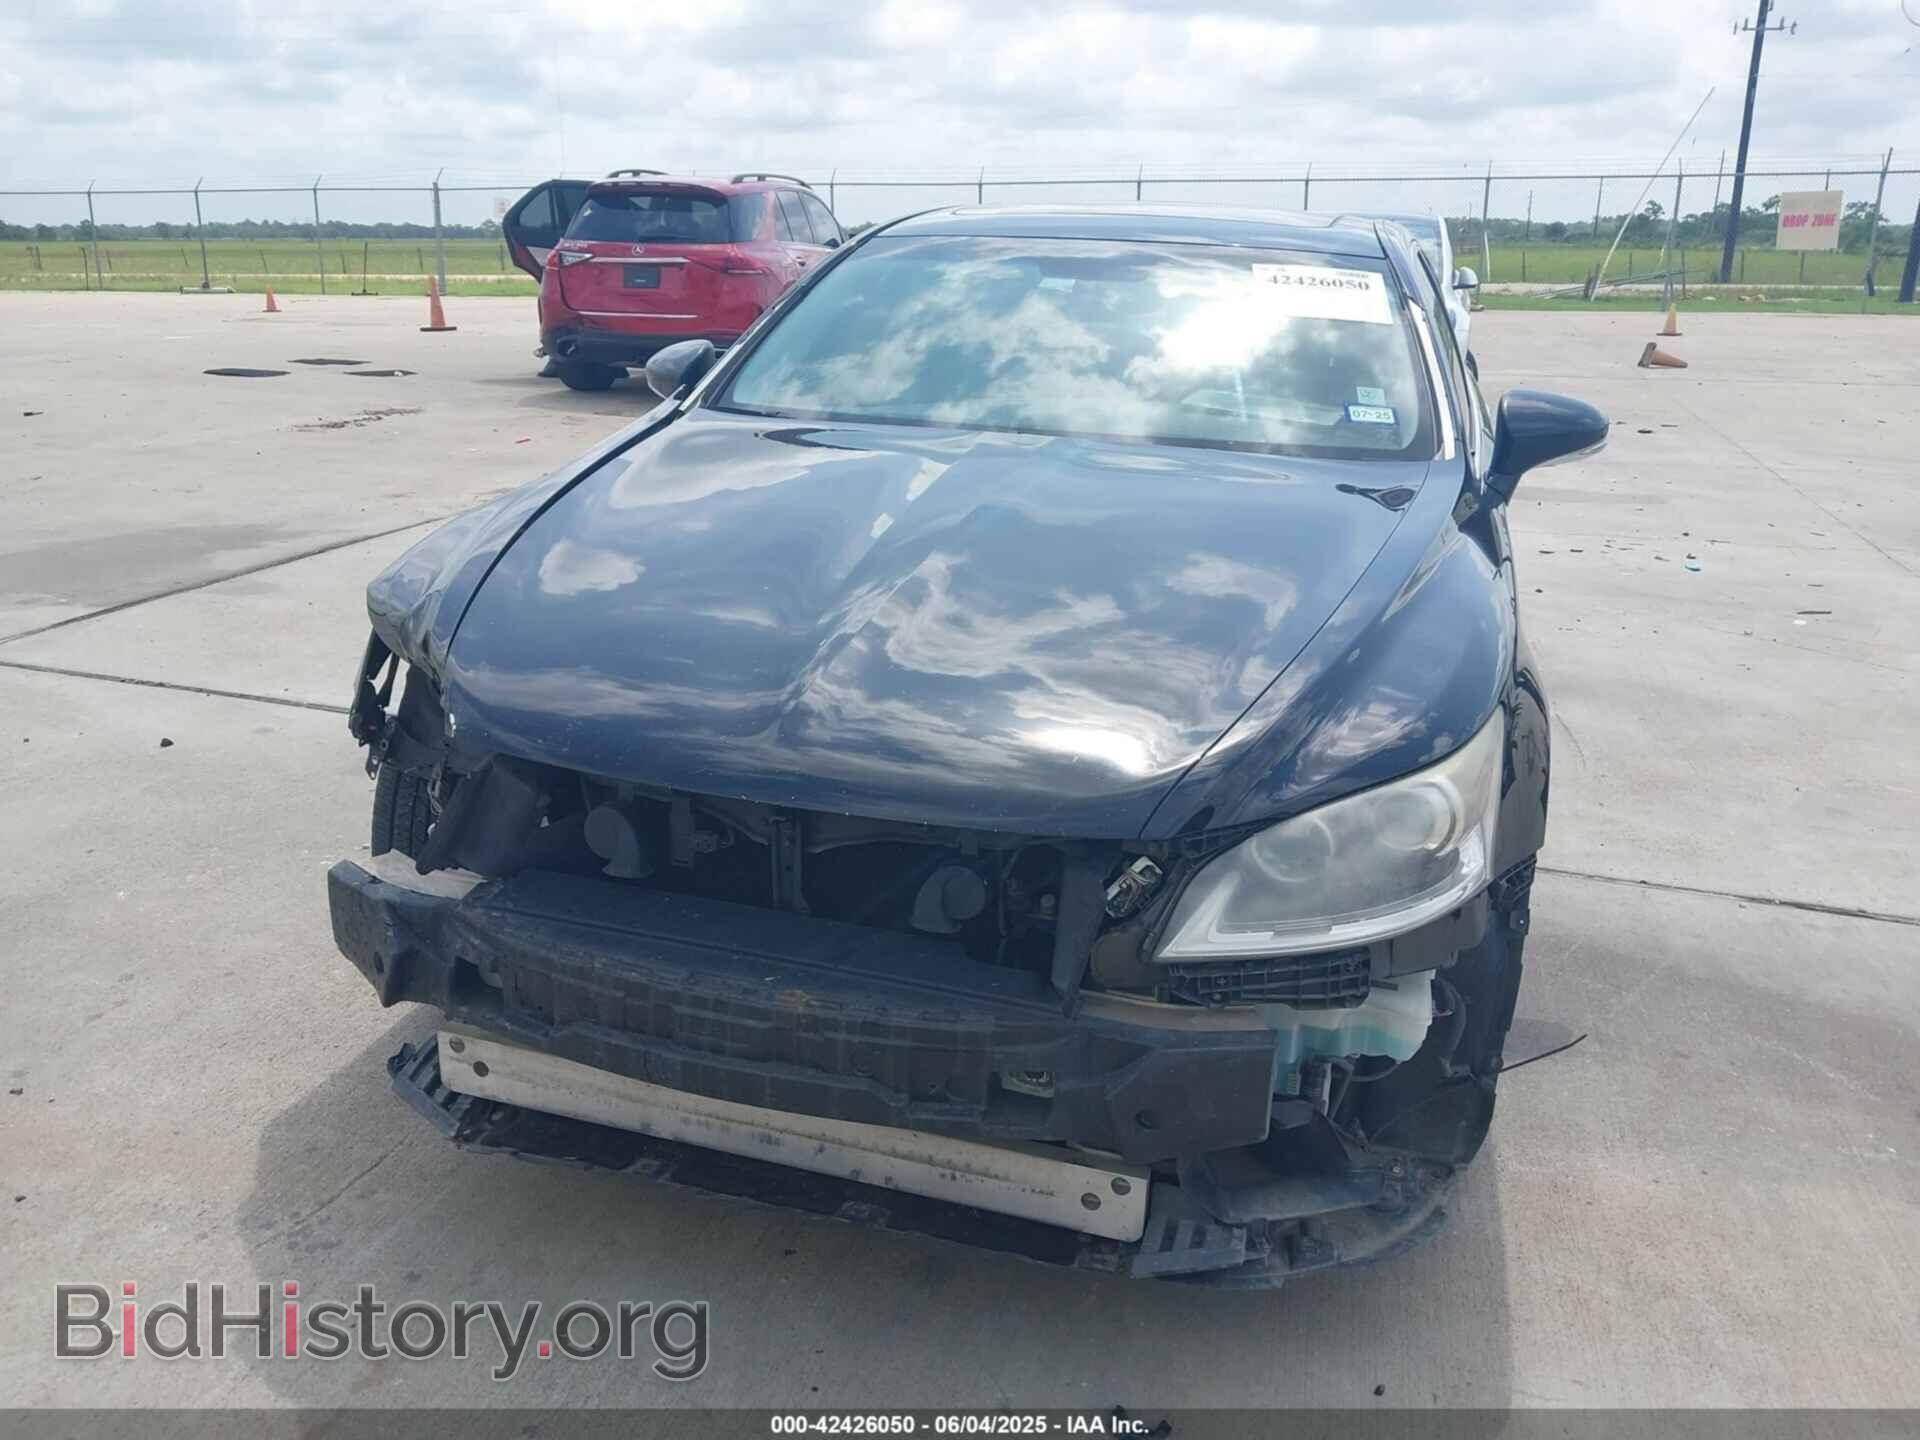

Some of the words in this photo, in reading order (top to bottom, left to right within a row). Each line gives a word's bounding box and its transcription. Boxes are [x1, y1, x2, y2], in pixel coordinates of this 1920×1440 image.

[1782, 213, 1809, 228] DROP
[1811, 212, 1837, 227] ZONE
[1266, 273, 1371, 291] 42426050
